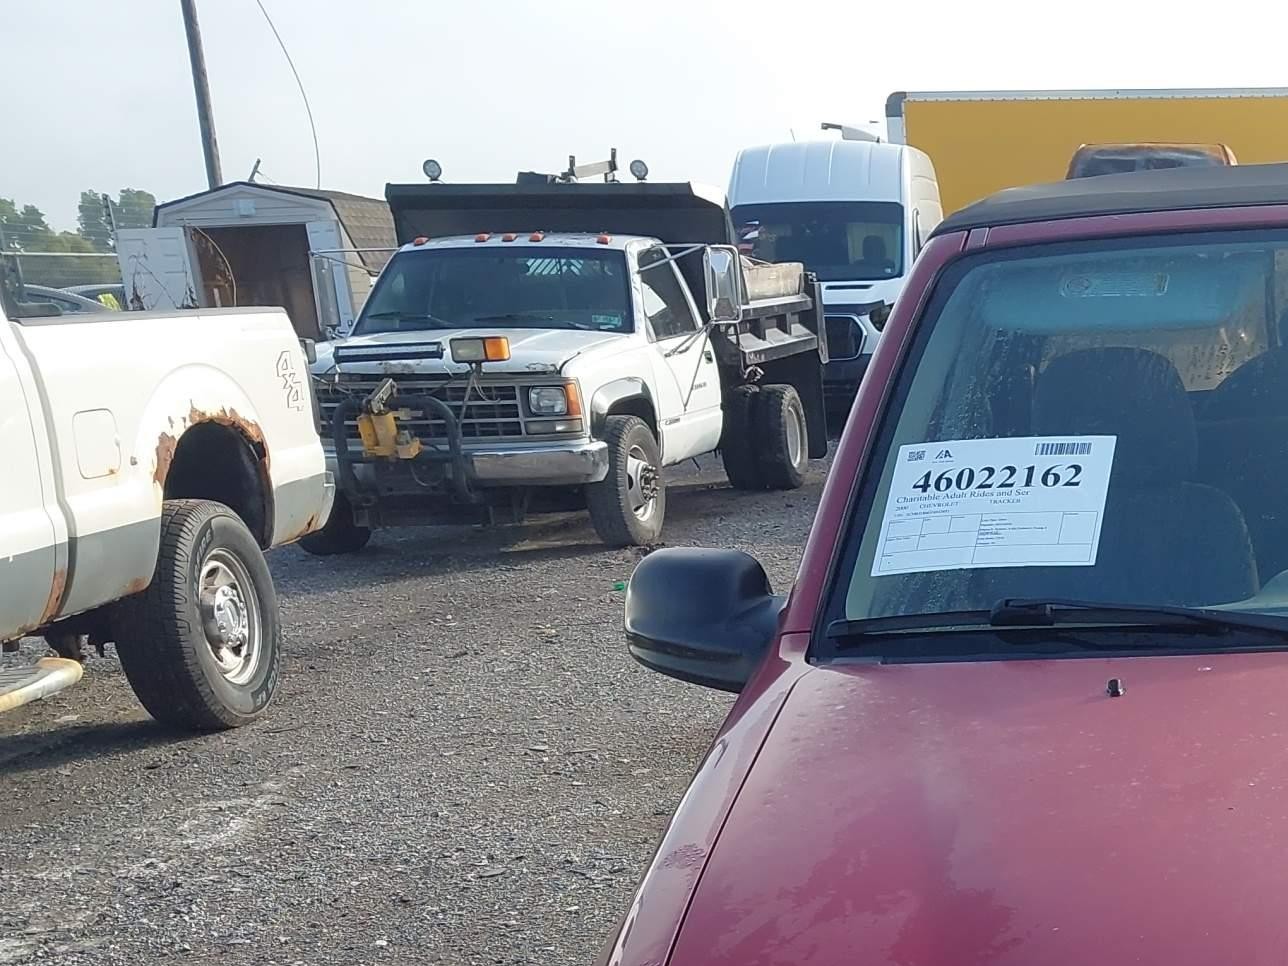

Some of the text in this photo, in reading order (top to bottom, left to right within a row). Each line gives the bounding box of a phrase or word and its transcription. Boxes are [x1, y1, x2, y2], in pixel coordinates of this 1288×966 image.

[912, 464, 1082, 493] 46022162
[896, 488, 1031, 503] Charitable Adult Rides and Ser
